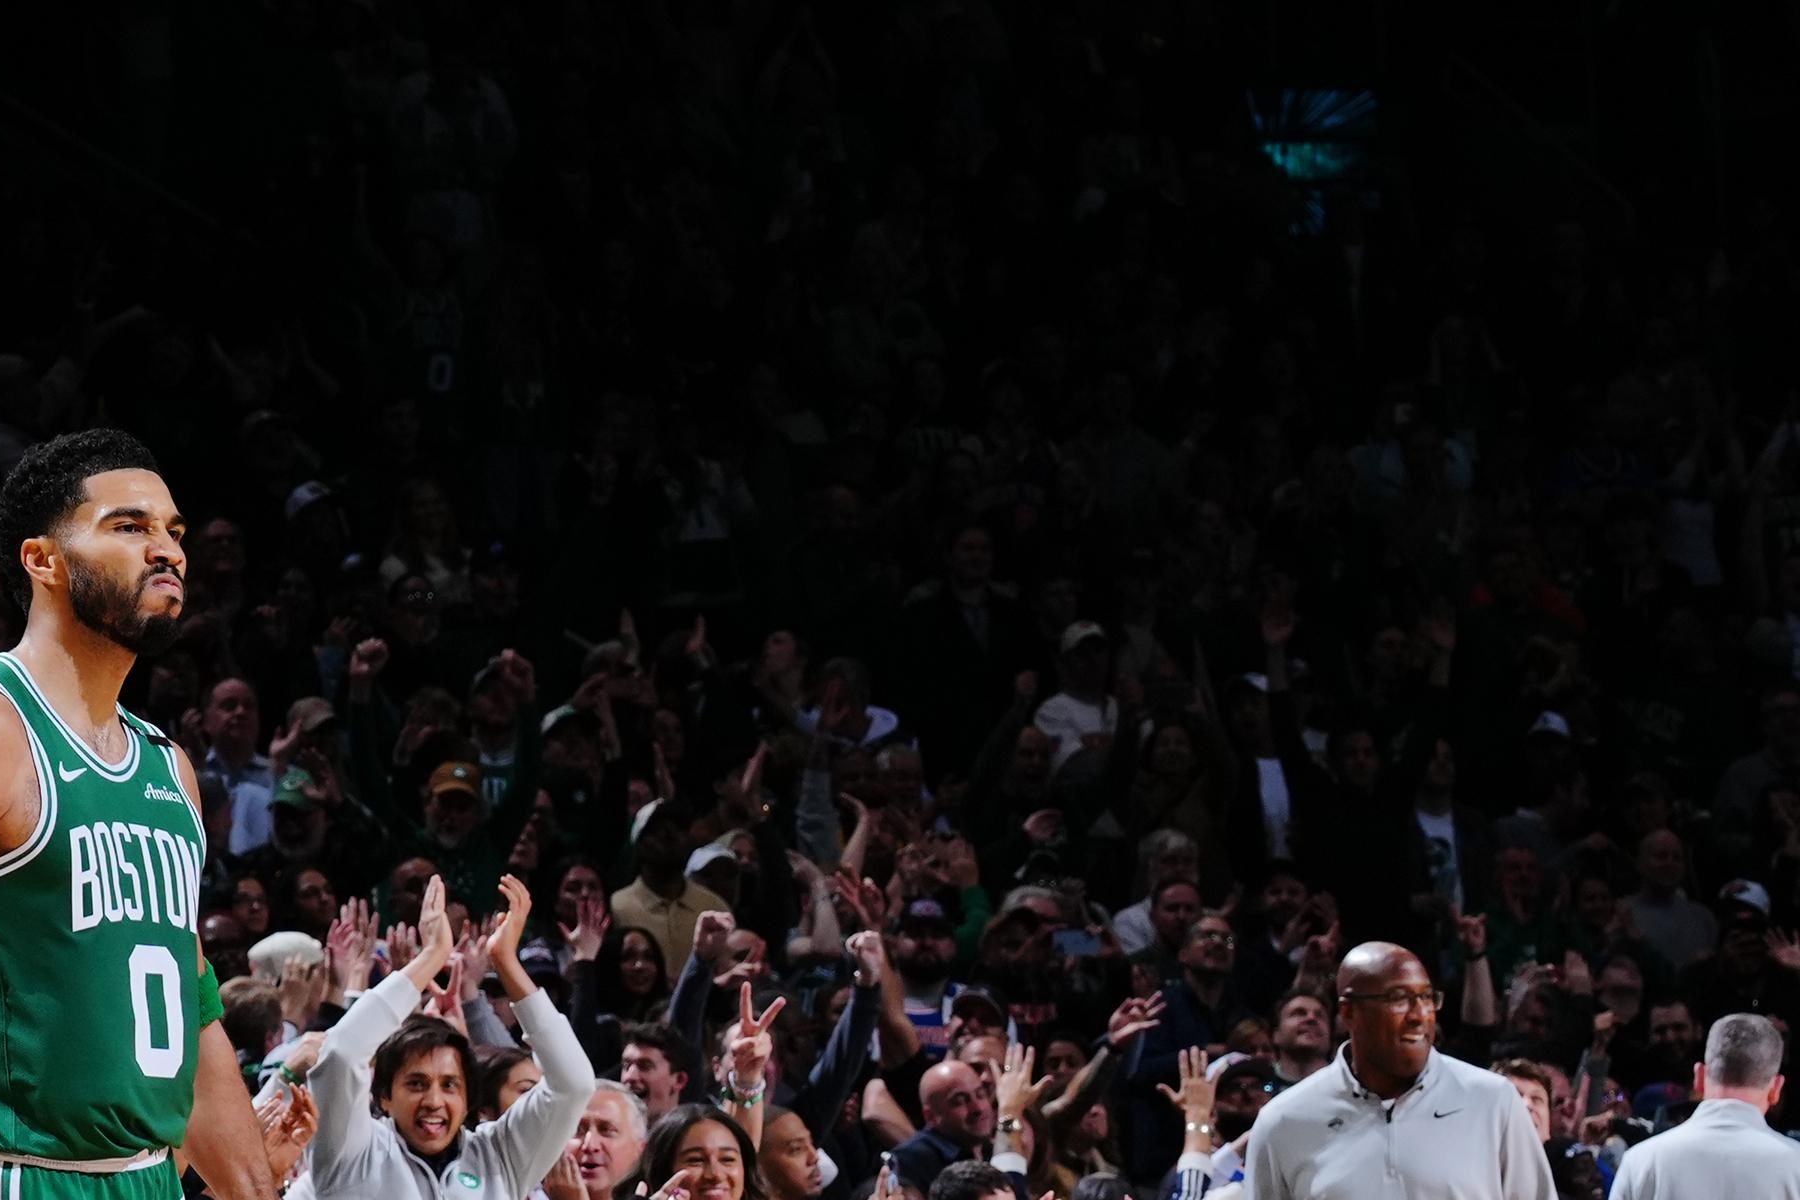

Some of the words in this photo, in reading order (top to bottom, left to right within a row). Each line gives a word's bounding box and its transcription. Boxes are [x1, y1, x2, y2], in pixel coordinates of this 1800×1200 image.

[144, 782, 184, 804] Amica
[69, 821, 200, 934] BOSTON
[129, 944, 185, 1078] 0
